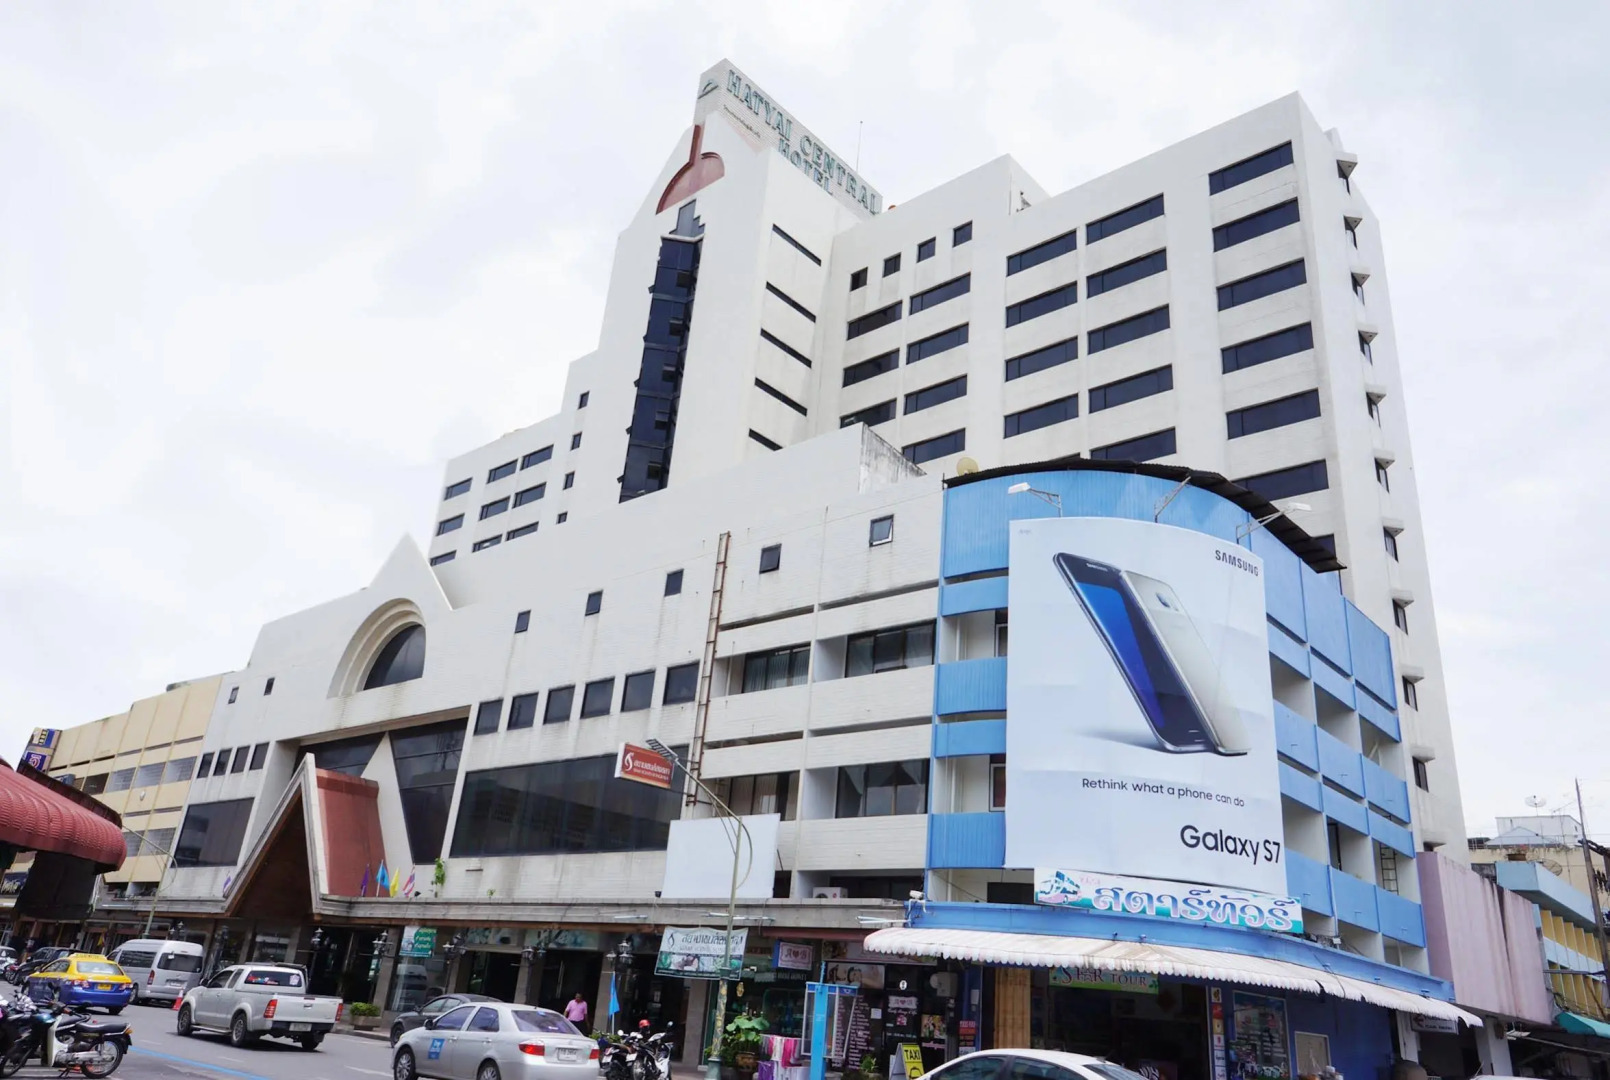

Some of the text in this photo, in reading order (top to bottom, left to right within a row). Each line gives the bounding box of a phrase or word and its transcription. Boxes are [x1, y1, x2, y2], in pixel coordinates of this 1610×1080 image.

[727, 69, 793, 142] HATYAI
[800, 135, 879, 216] CENTRAL
[778, 137, 833, 196] HOTEL
[1215, 549, 1259, 577] SAMSUNG
[1082, 778, 1245, 807] Rethink what a phone can do
[1180, 825, 1281, 865] Galaxy S7
[1093, 887, 1294, 931] สตาร์ทัวร์
[1110, 973, 1147, 986] TOUR
[904, 1049, 921, 1061] TAXI
